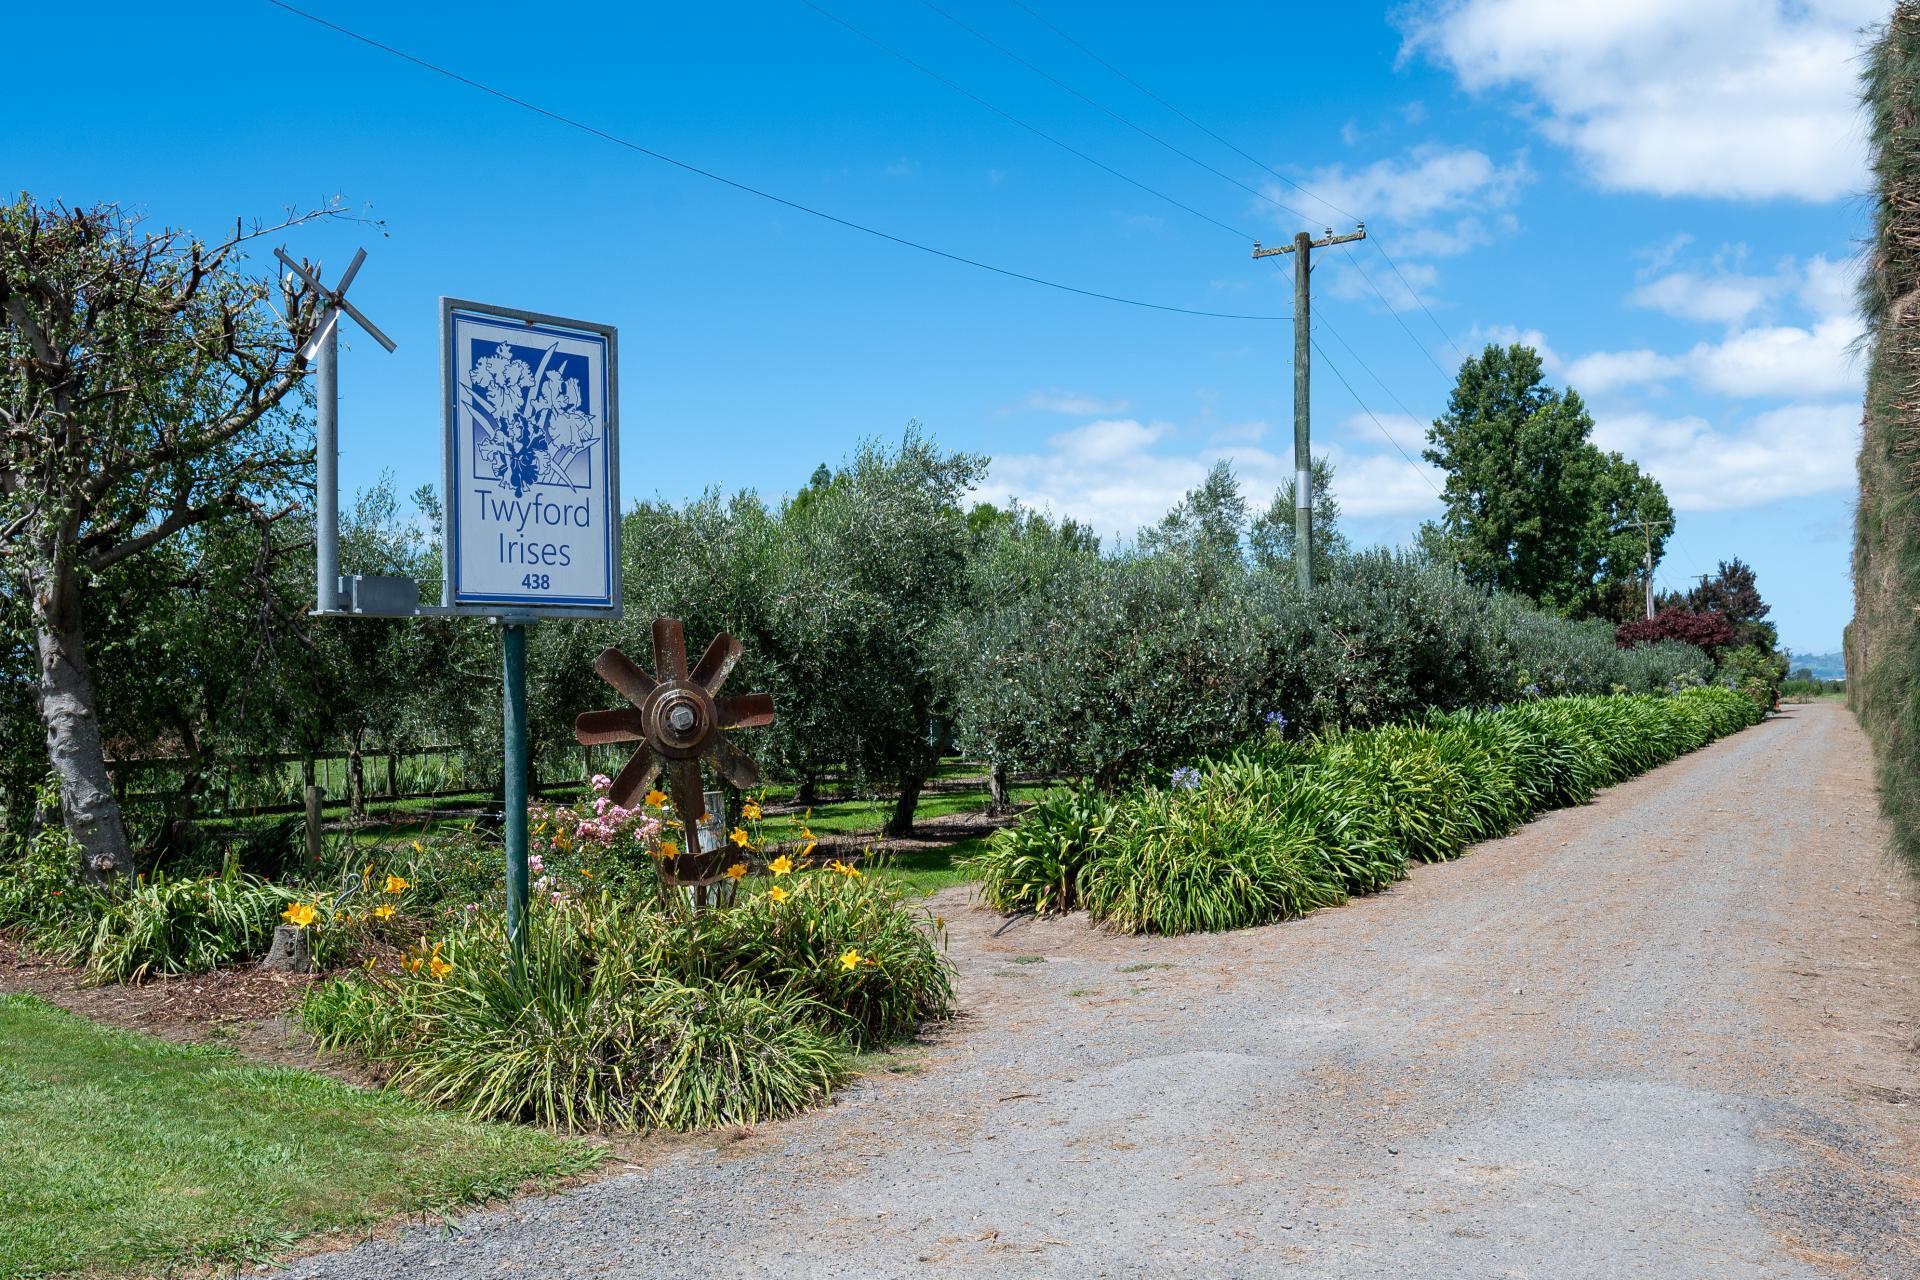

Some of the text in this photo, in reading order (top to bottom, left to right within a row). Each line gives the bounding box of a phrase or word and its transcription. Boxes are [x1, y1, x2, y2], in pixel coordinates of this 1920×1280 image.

[474, 489, 590, 532] Twyford
[500, 533, 571, 566] Irises
[521, 574, 550, 590] 438
